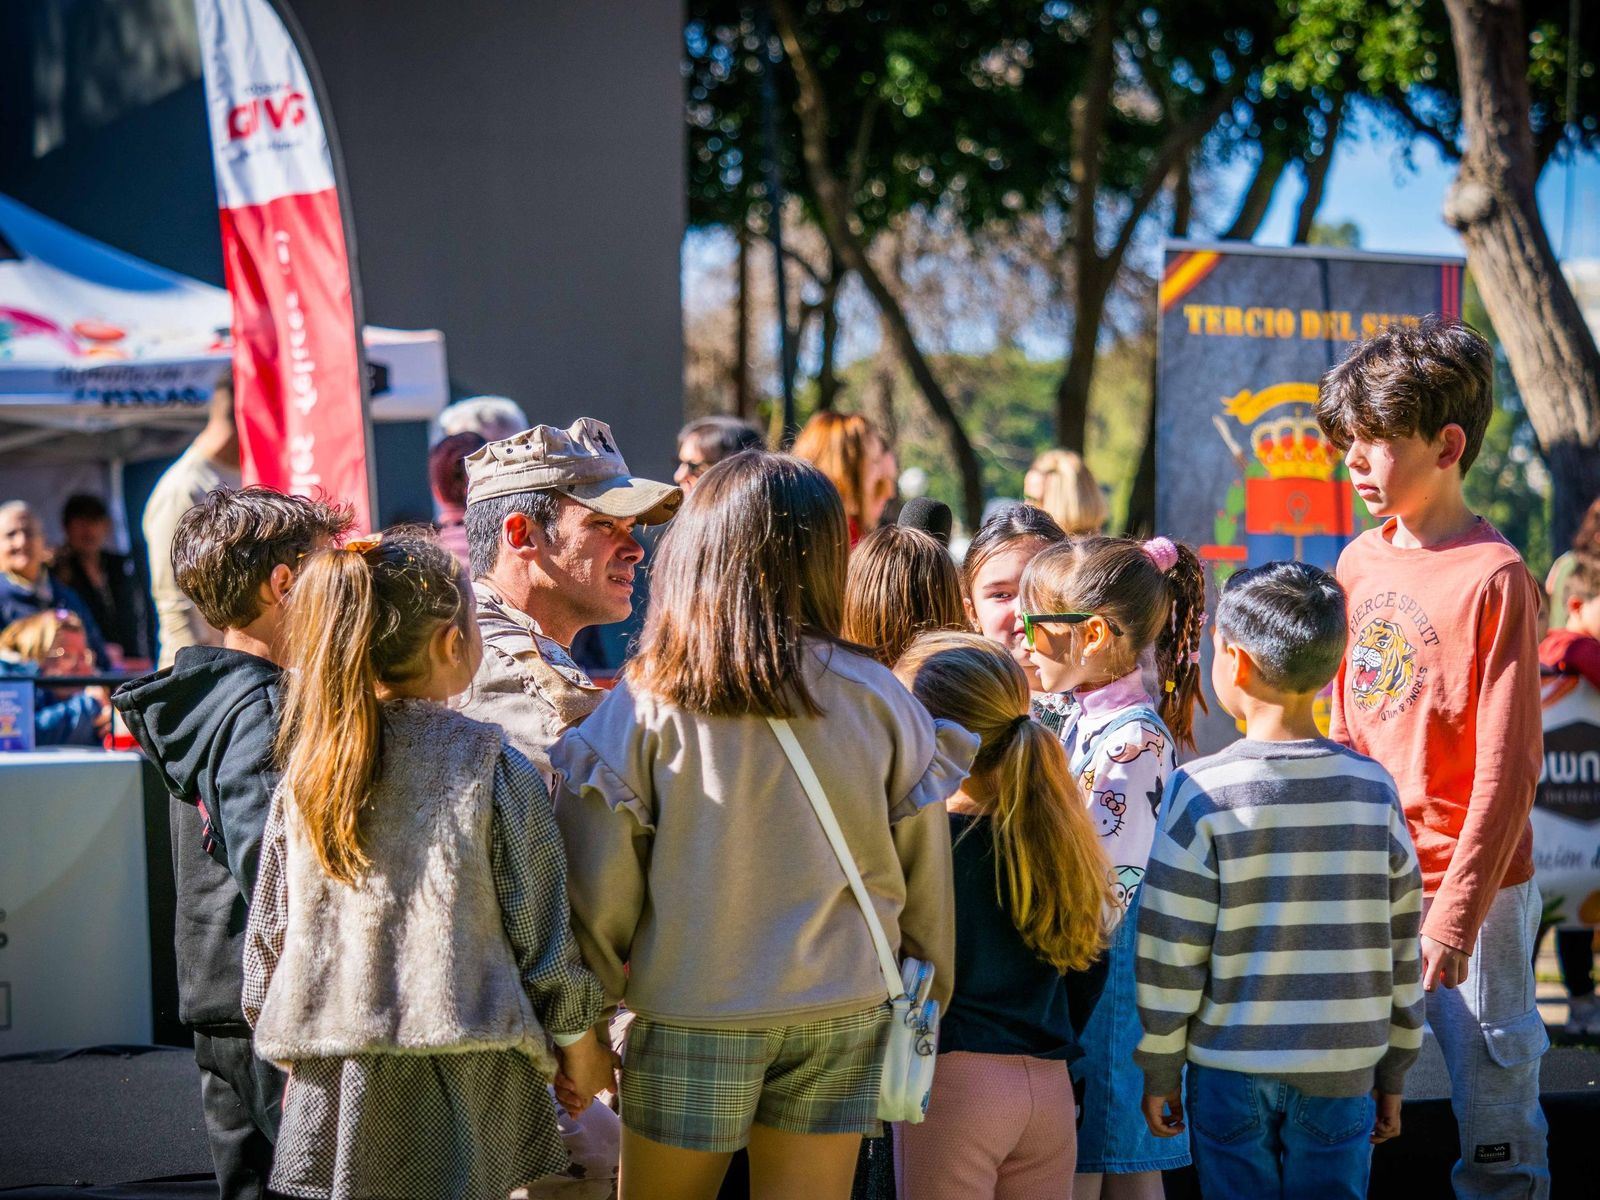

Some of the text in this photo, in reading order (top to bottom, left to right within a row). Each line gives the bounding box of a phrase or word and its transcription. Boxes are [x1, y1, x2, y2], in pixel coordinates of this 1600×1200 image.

[1183, 304, 1295, 338] TERCIO
[1301, 309, 1356, 341] DEL
[1349, 591, 1440, 646] FIERCE SPIRIT
[1380, 666, 1428, 721] STRONG & WILD
[1539, 751, 1600, 784] wn
